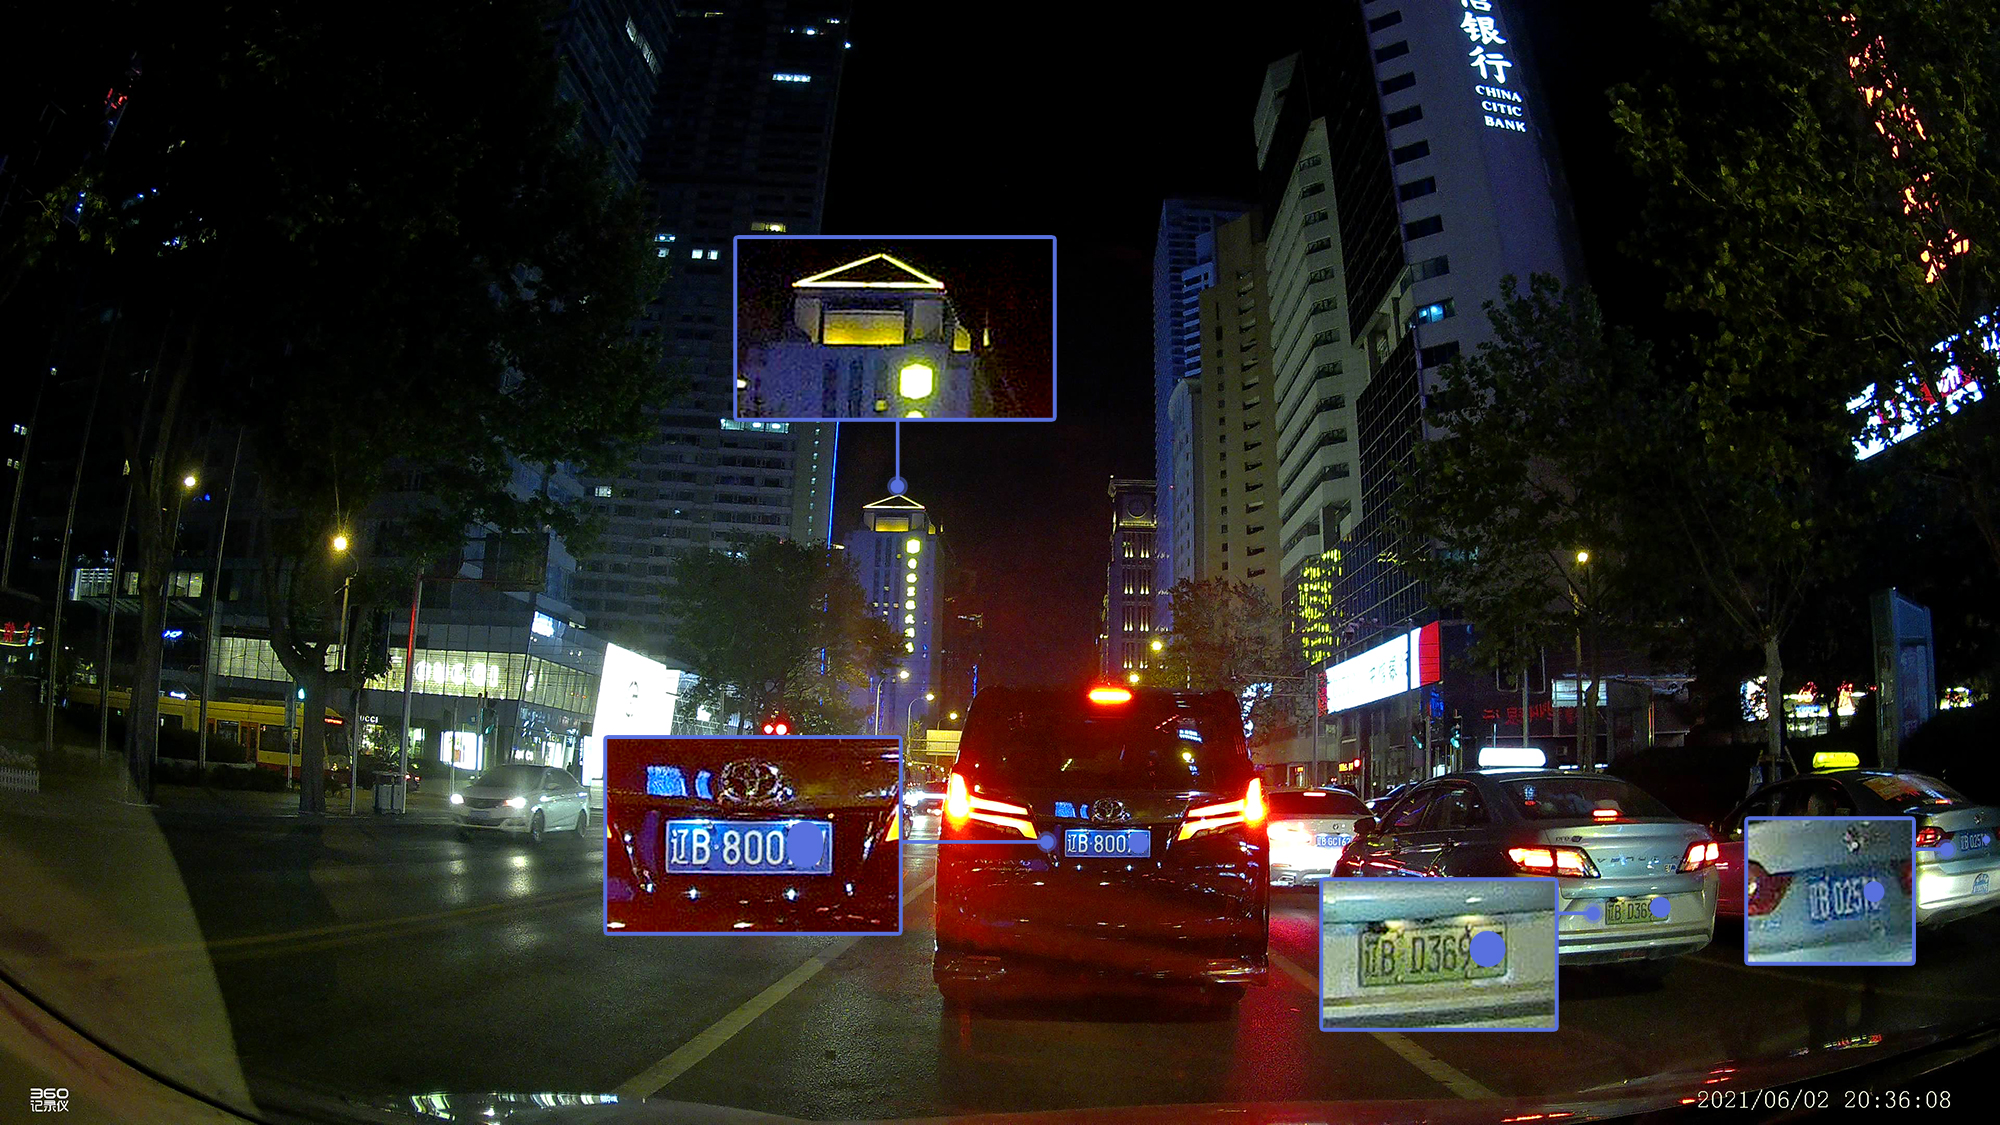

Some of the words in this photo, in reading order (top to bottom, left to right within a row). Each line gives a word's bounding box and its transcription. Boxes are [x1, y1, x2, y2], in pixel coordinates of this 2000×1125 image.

[1475, 85, 1523, 103] CHINA
[1482, 100, 1523, 117] CITIC
[1484, 115, 1527, 133] BANK
[359, 715, 379, 724] UCCI
